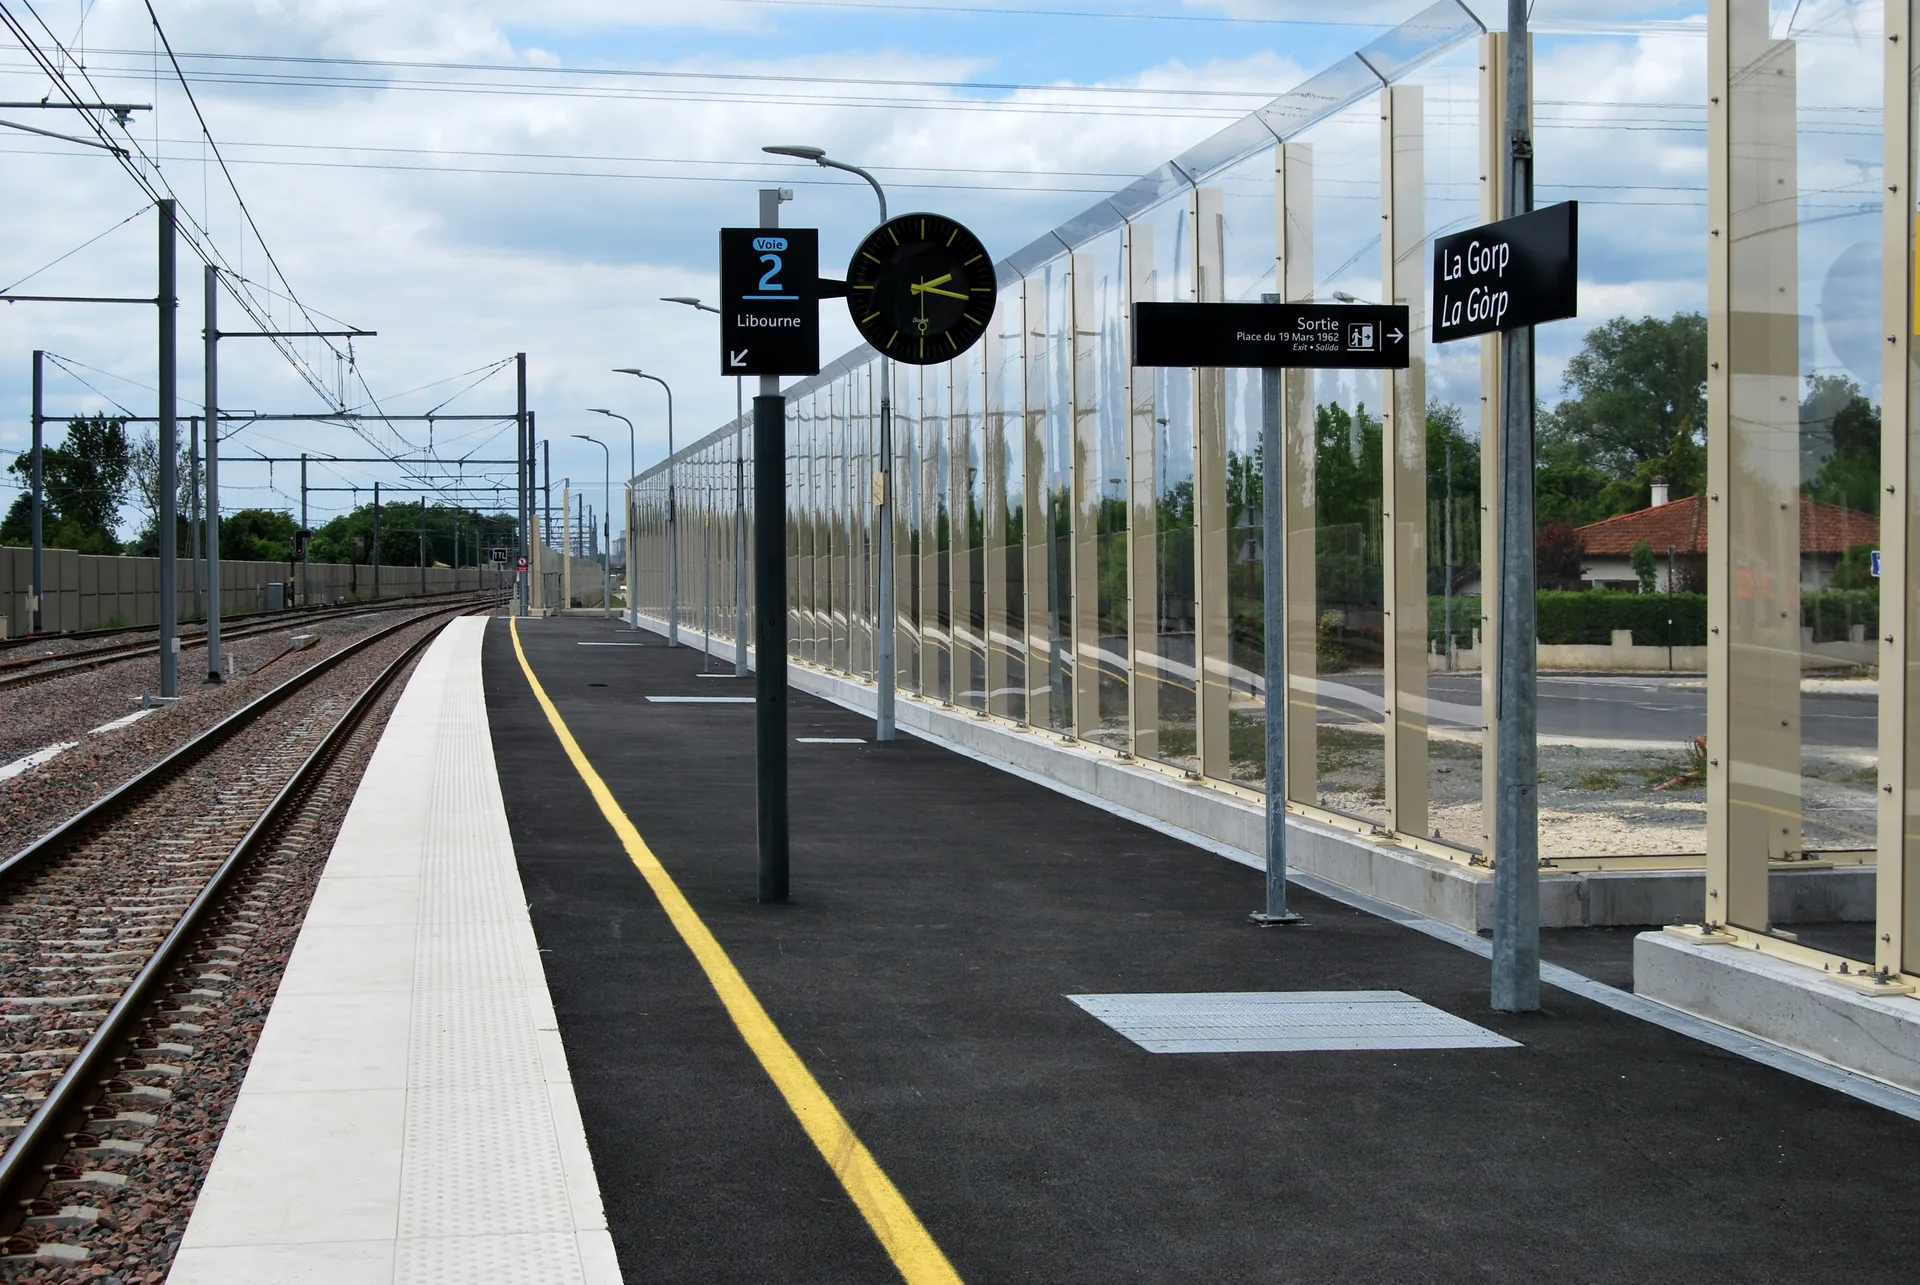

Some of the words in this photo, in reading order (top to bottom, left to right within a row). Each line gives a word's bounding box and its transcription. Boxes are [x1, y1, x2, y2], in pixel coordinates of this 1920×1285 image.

[756, 239, 783, 250] Voie
[1444, 249, 1461, 281] La
[1468, 240, 1509, 278] Gorp
[758, 253, 782, 291] 2
[1442, 294, 1462, 328] La
[1467, 285, 1508, 326] Gòrp
[737, 314, 801, 327] Libourne
[1297, 316, 1339, 330] Sortie
[1236, 332, 1261, 341] Place
[1265, 332, 1276, 341] du
[1278, 332, 1290, 342] 19
[1292, 332, 1315, 342] Mars
[1317, 332, 1339, 342] 1962
[1292, 343, 1308, 351] Exit
